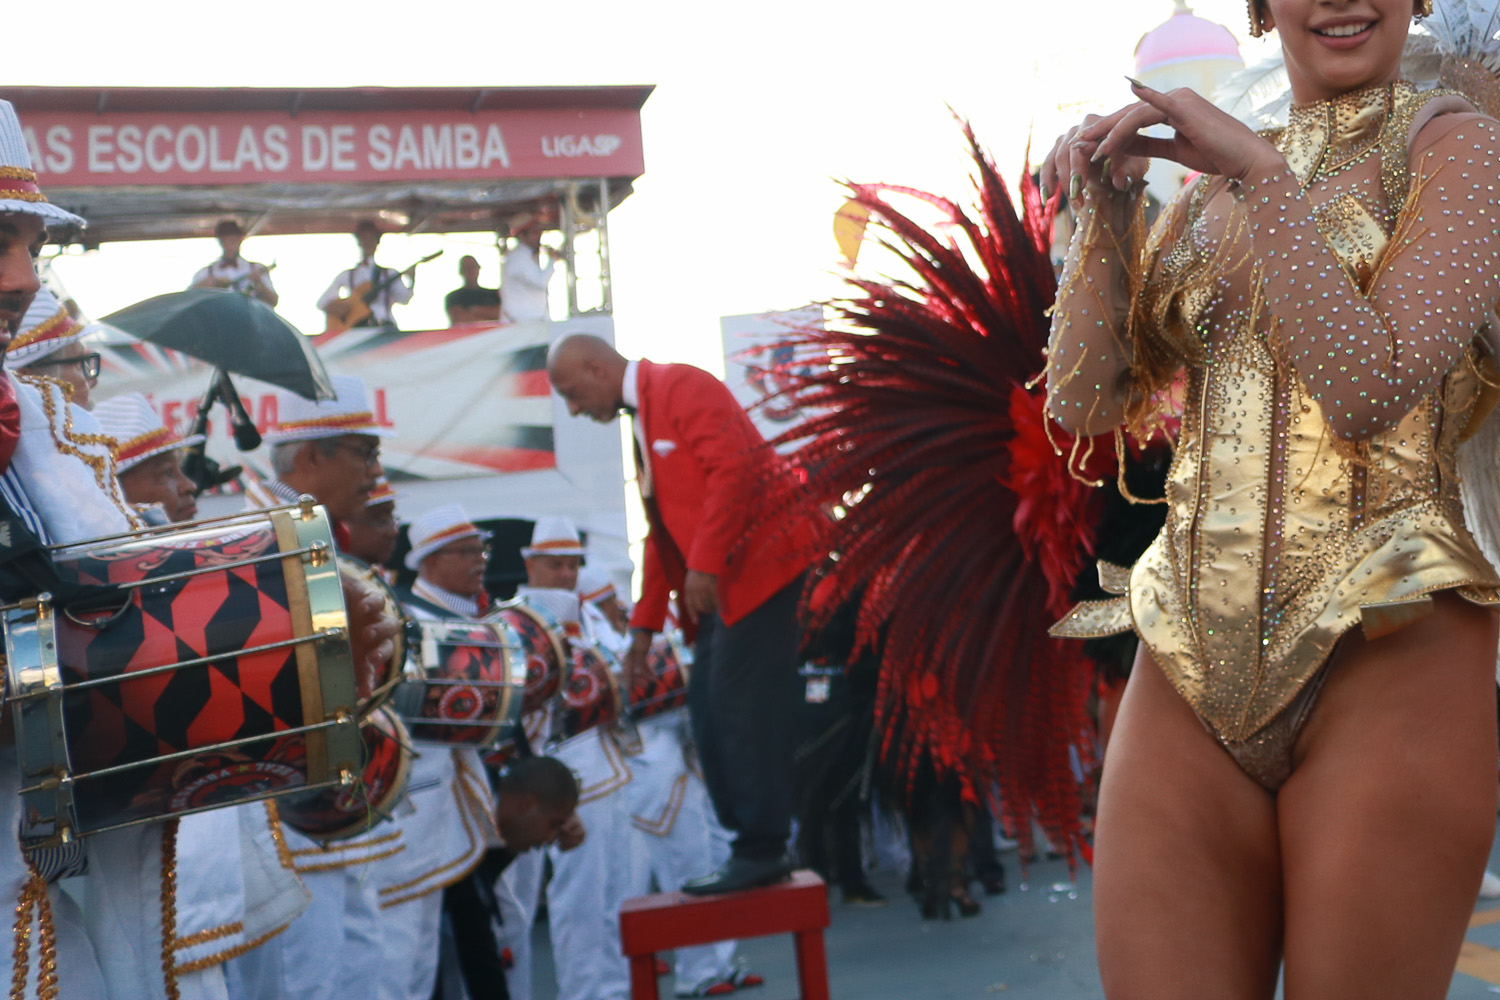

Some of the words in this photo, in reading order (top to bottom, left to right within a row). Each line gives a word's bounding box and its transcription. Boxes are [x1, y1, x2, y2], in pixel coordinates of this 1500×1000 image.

[88, 124, 290, 173] ESCOLAS
[302, 125, 358, 172] DE
[367, 124, 510, 170] SAMBA
